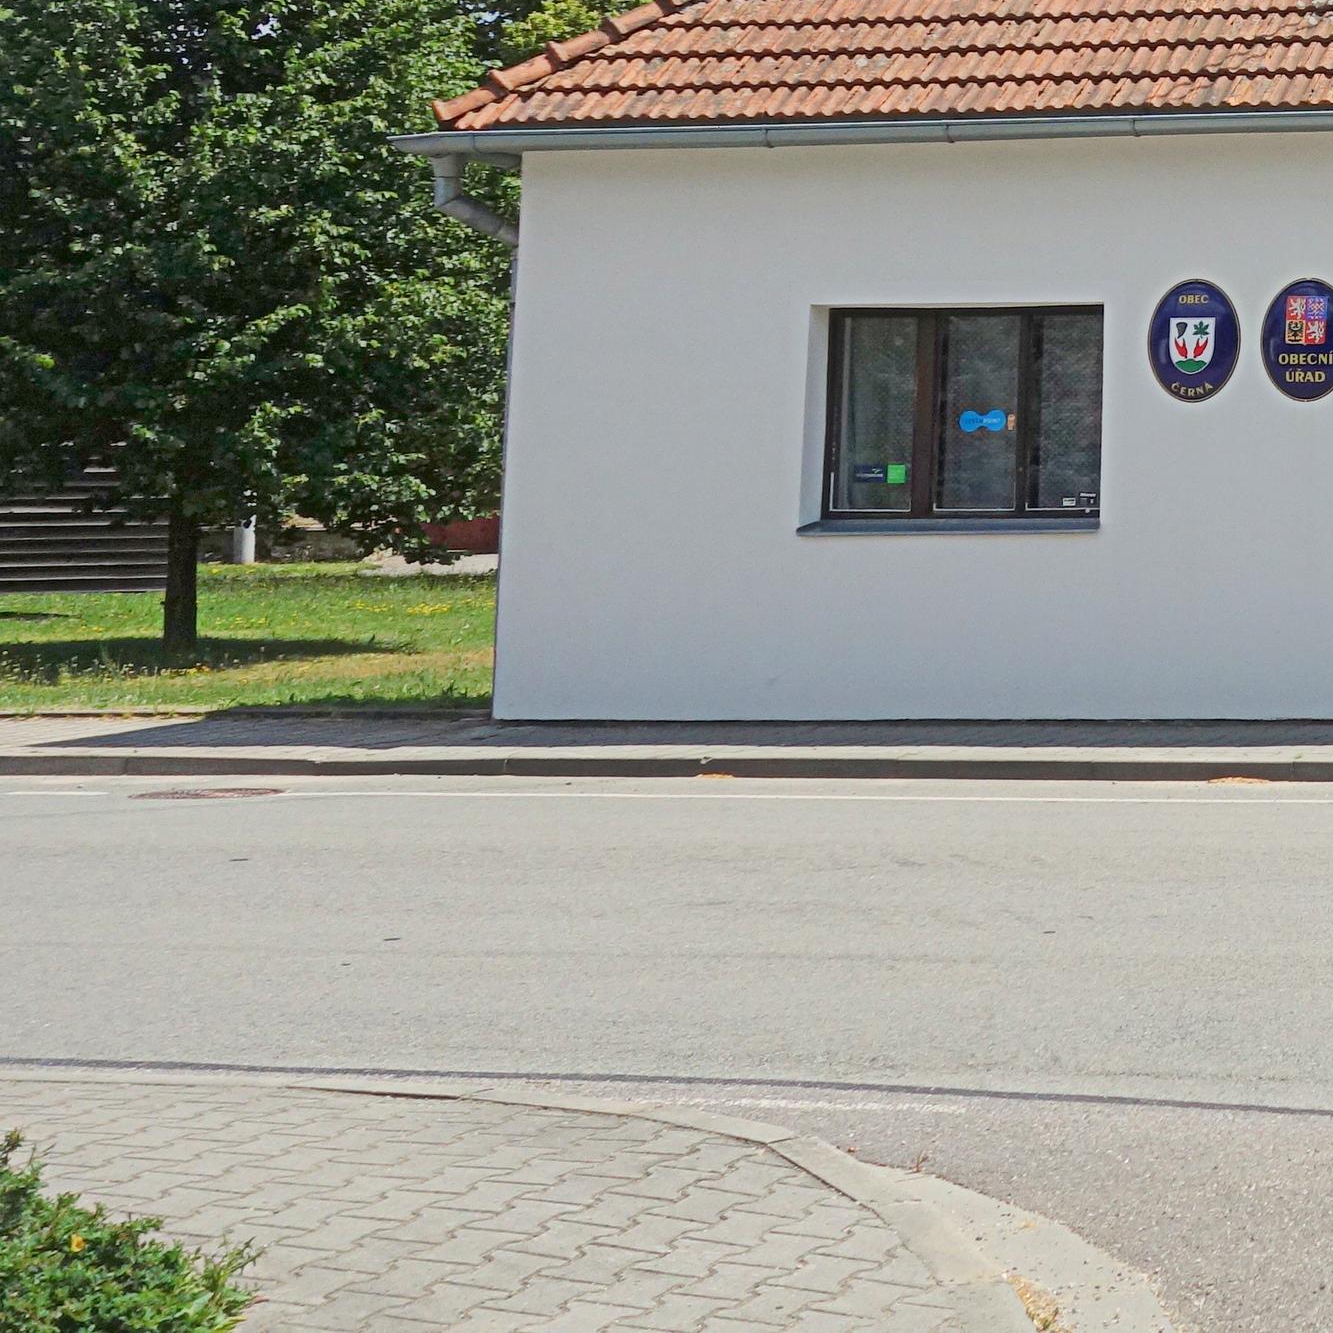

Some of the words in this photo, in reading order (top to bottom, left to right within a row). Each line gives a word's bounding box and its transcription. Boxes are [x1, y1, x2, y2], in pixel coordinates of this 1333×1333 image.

[1178, 294, 1209, 304] OBEC
[1278, 350, 1333, 365] OBECNÍ
[1285, 368, 1326, 383] ÚŘAD
